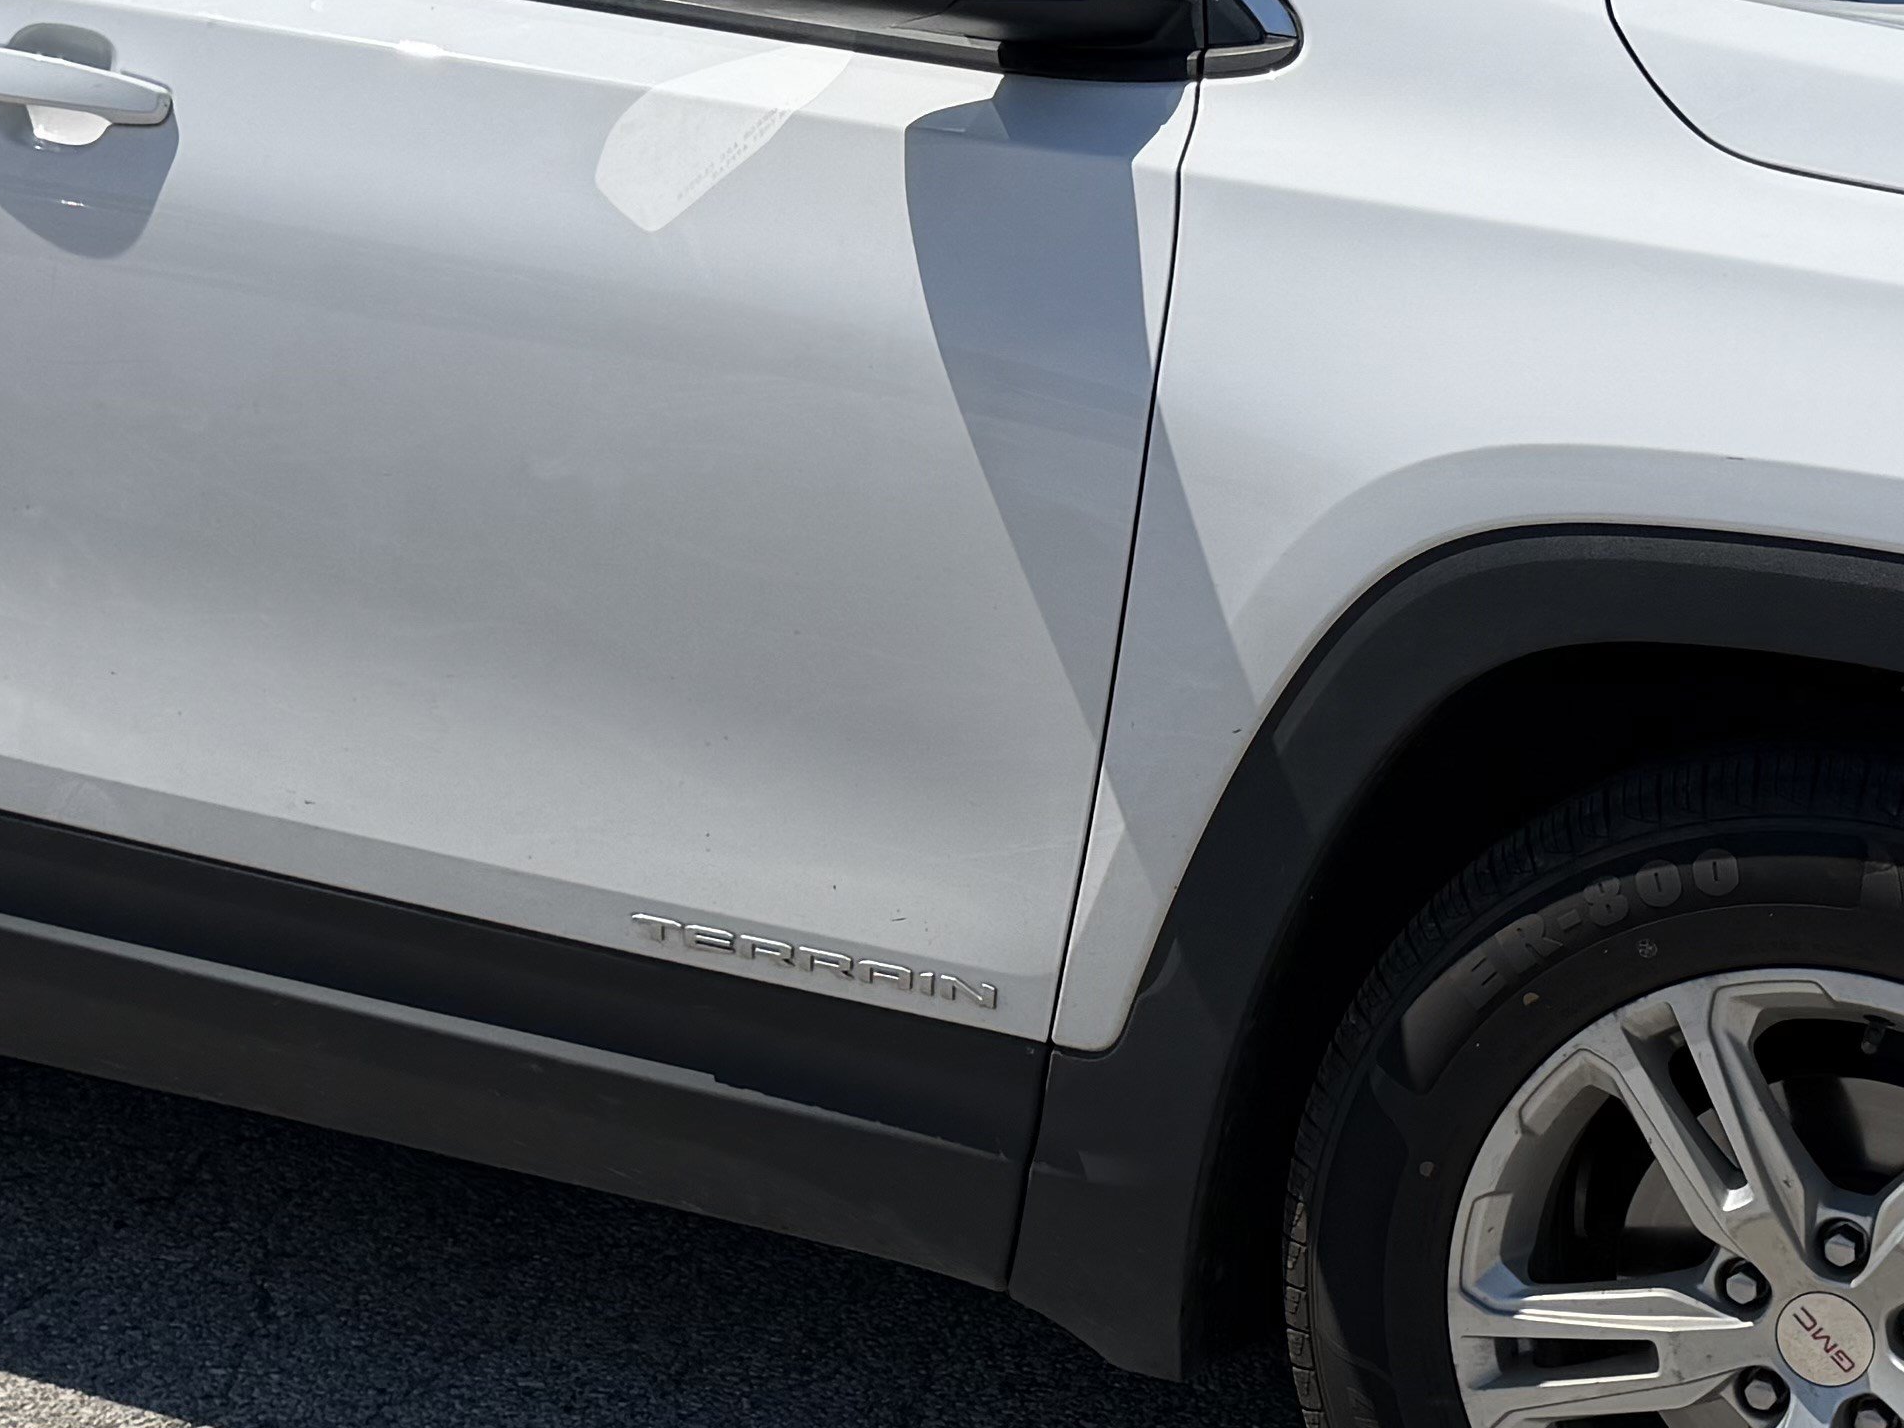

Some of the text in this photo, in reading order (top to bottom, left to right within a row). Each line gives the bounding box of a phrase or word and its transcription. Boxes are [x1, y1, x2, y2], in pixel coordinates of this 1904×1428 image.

[630, 912, 999, 1010] TERRAIN
[1461, 848, 1739, 1010] ER-800
[1792, 1305, 1856, 1373] GMC
